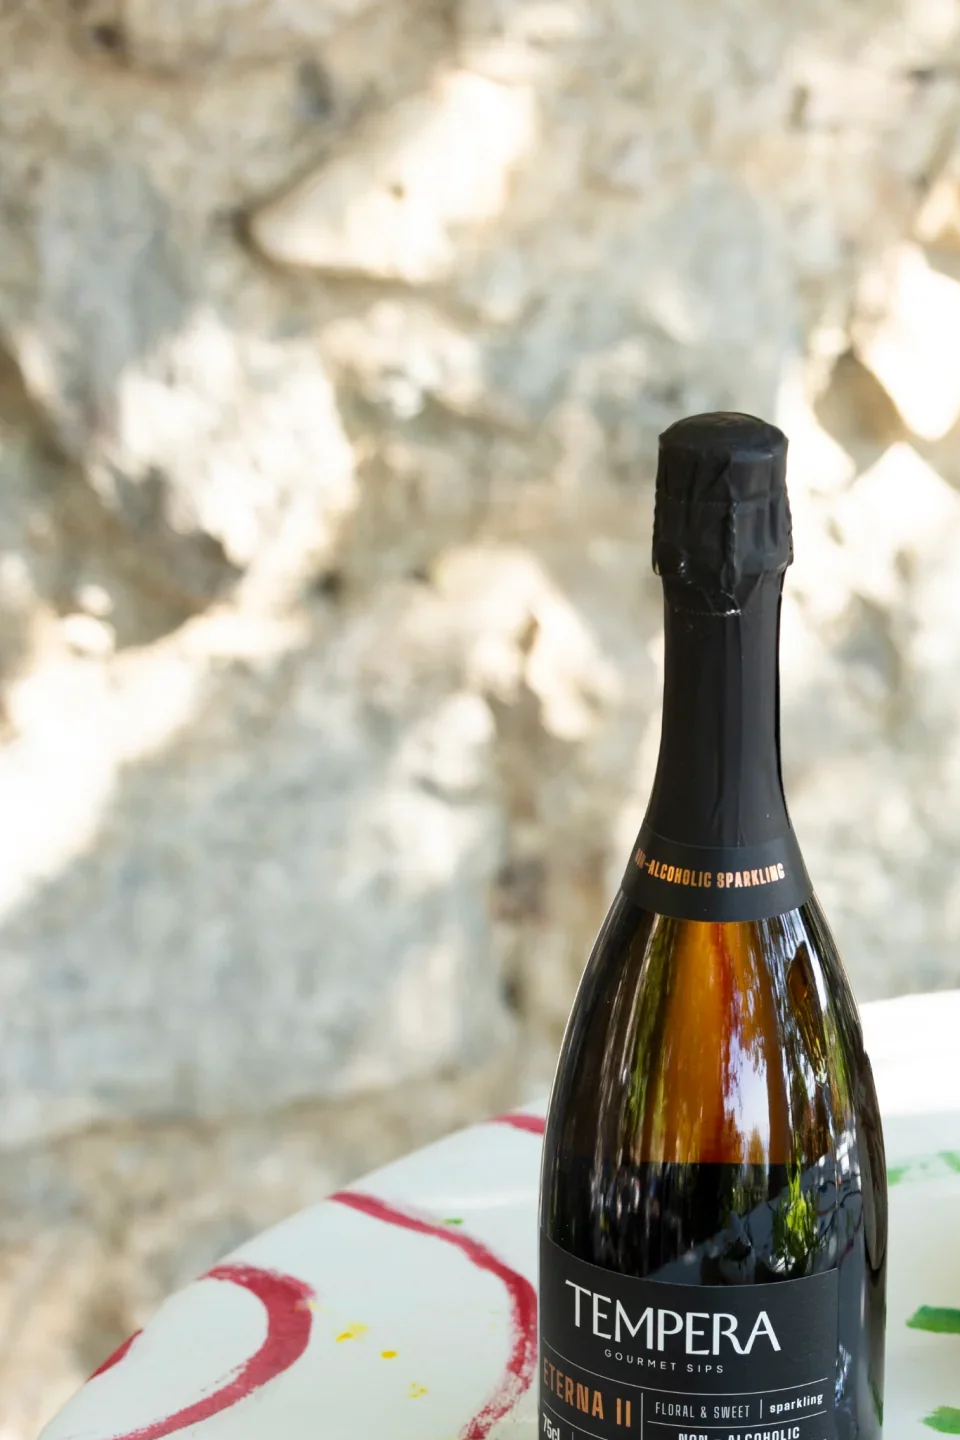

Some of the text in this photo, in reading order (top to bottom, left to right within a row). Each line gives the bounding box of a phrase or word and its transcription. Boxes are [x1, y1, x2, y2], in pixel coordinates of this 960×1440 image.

[716, 862, 785, 888] SPARKLING
[565, 1279, 781, 1355] TEMPERA
[604, 1349, 723, 1373] GOURMET SIPS
[543, 1357, 631, 1428] ETERNA II
[769, 1394, 823, 1414] sparkling
[655, 1401, 750, 1419] FLORAL & SWEET
